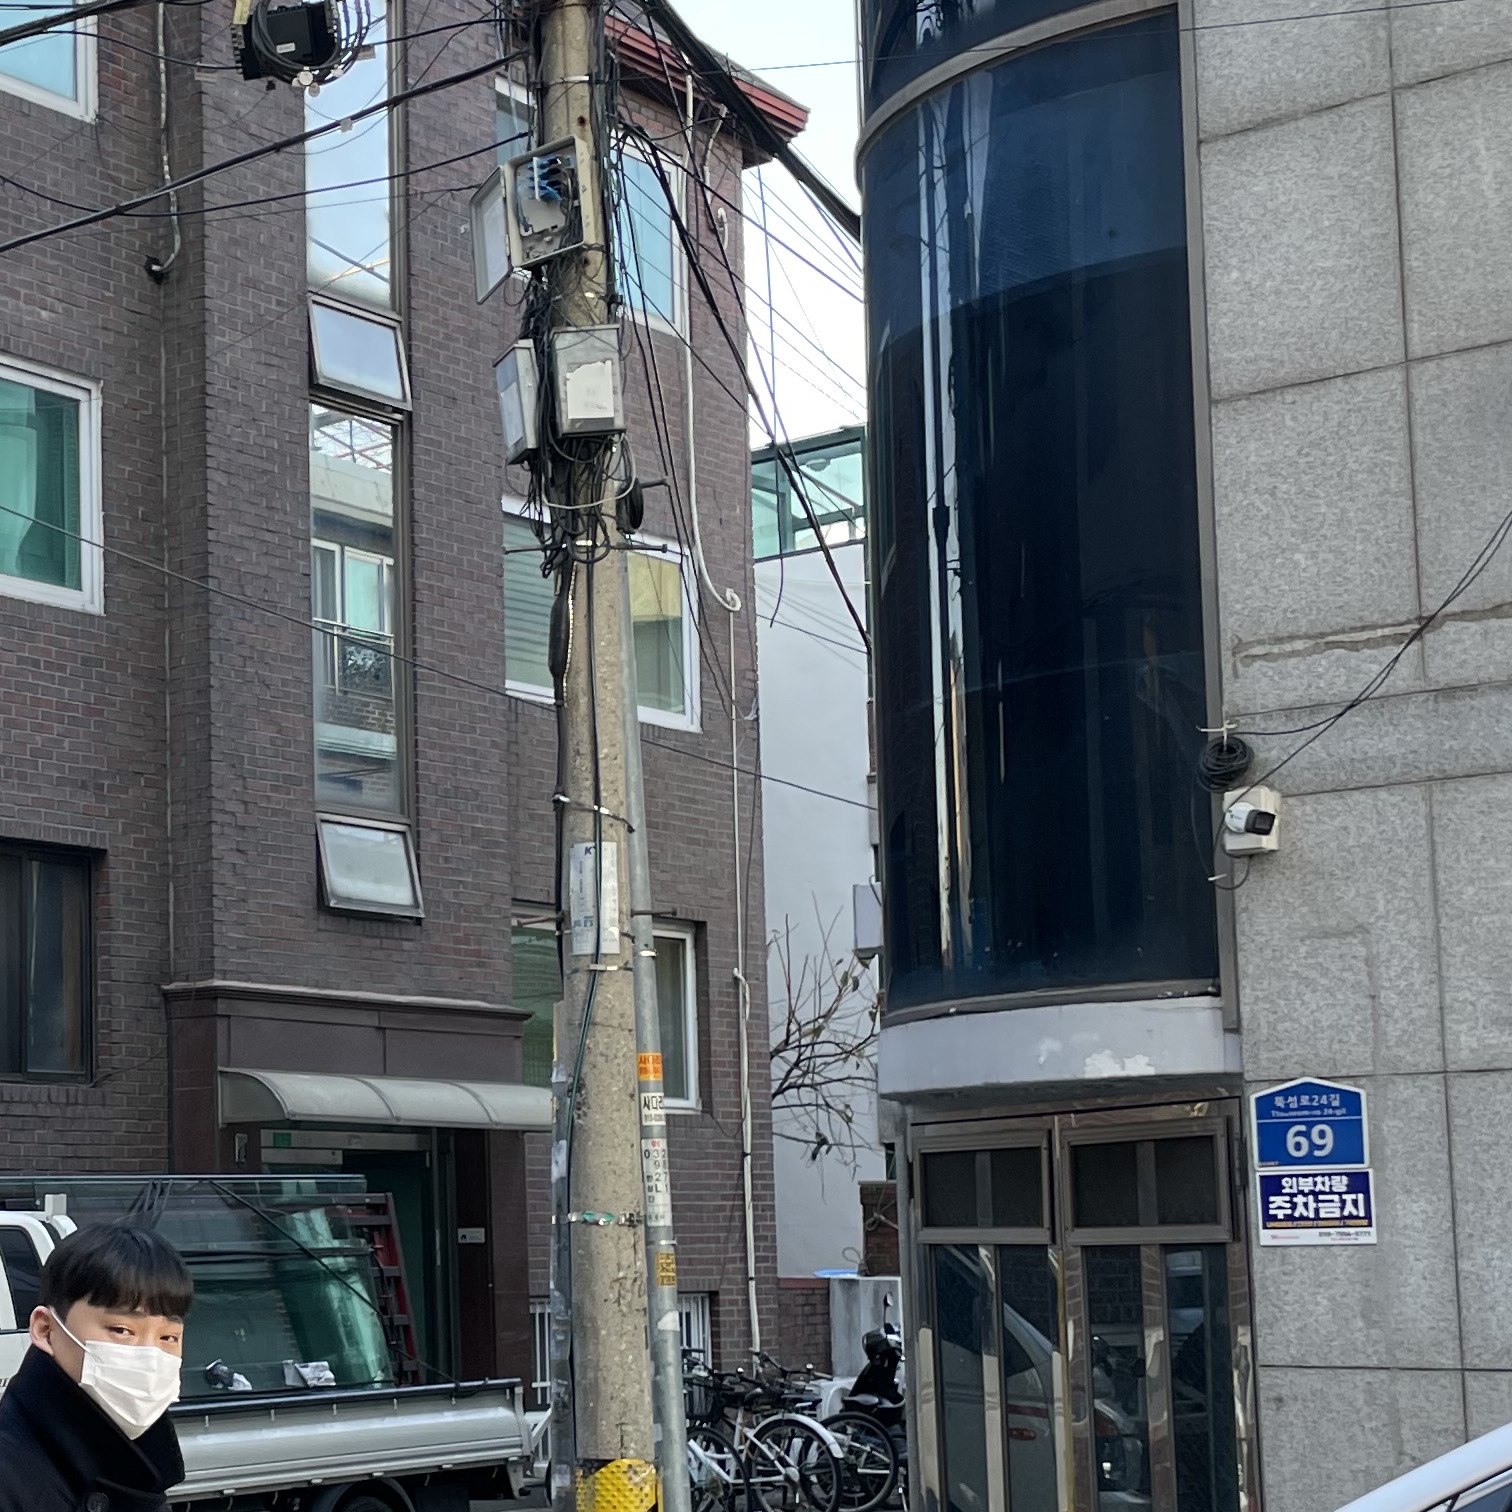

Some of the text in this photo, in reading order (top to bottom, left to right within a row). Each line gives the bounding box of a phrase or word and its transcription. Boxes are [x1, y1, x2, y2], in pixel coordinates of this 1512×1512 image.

[1286, 1123, 1334, 1158] 69
[1281, 1175, 1349, 1193] 외부차량
[1269, 1193, 1366, 1219] 주차금지
